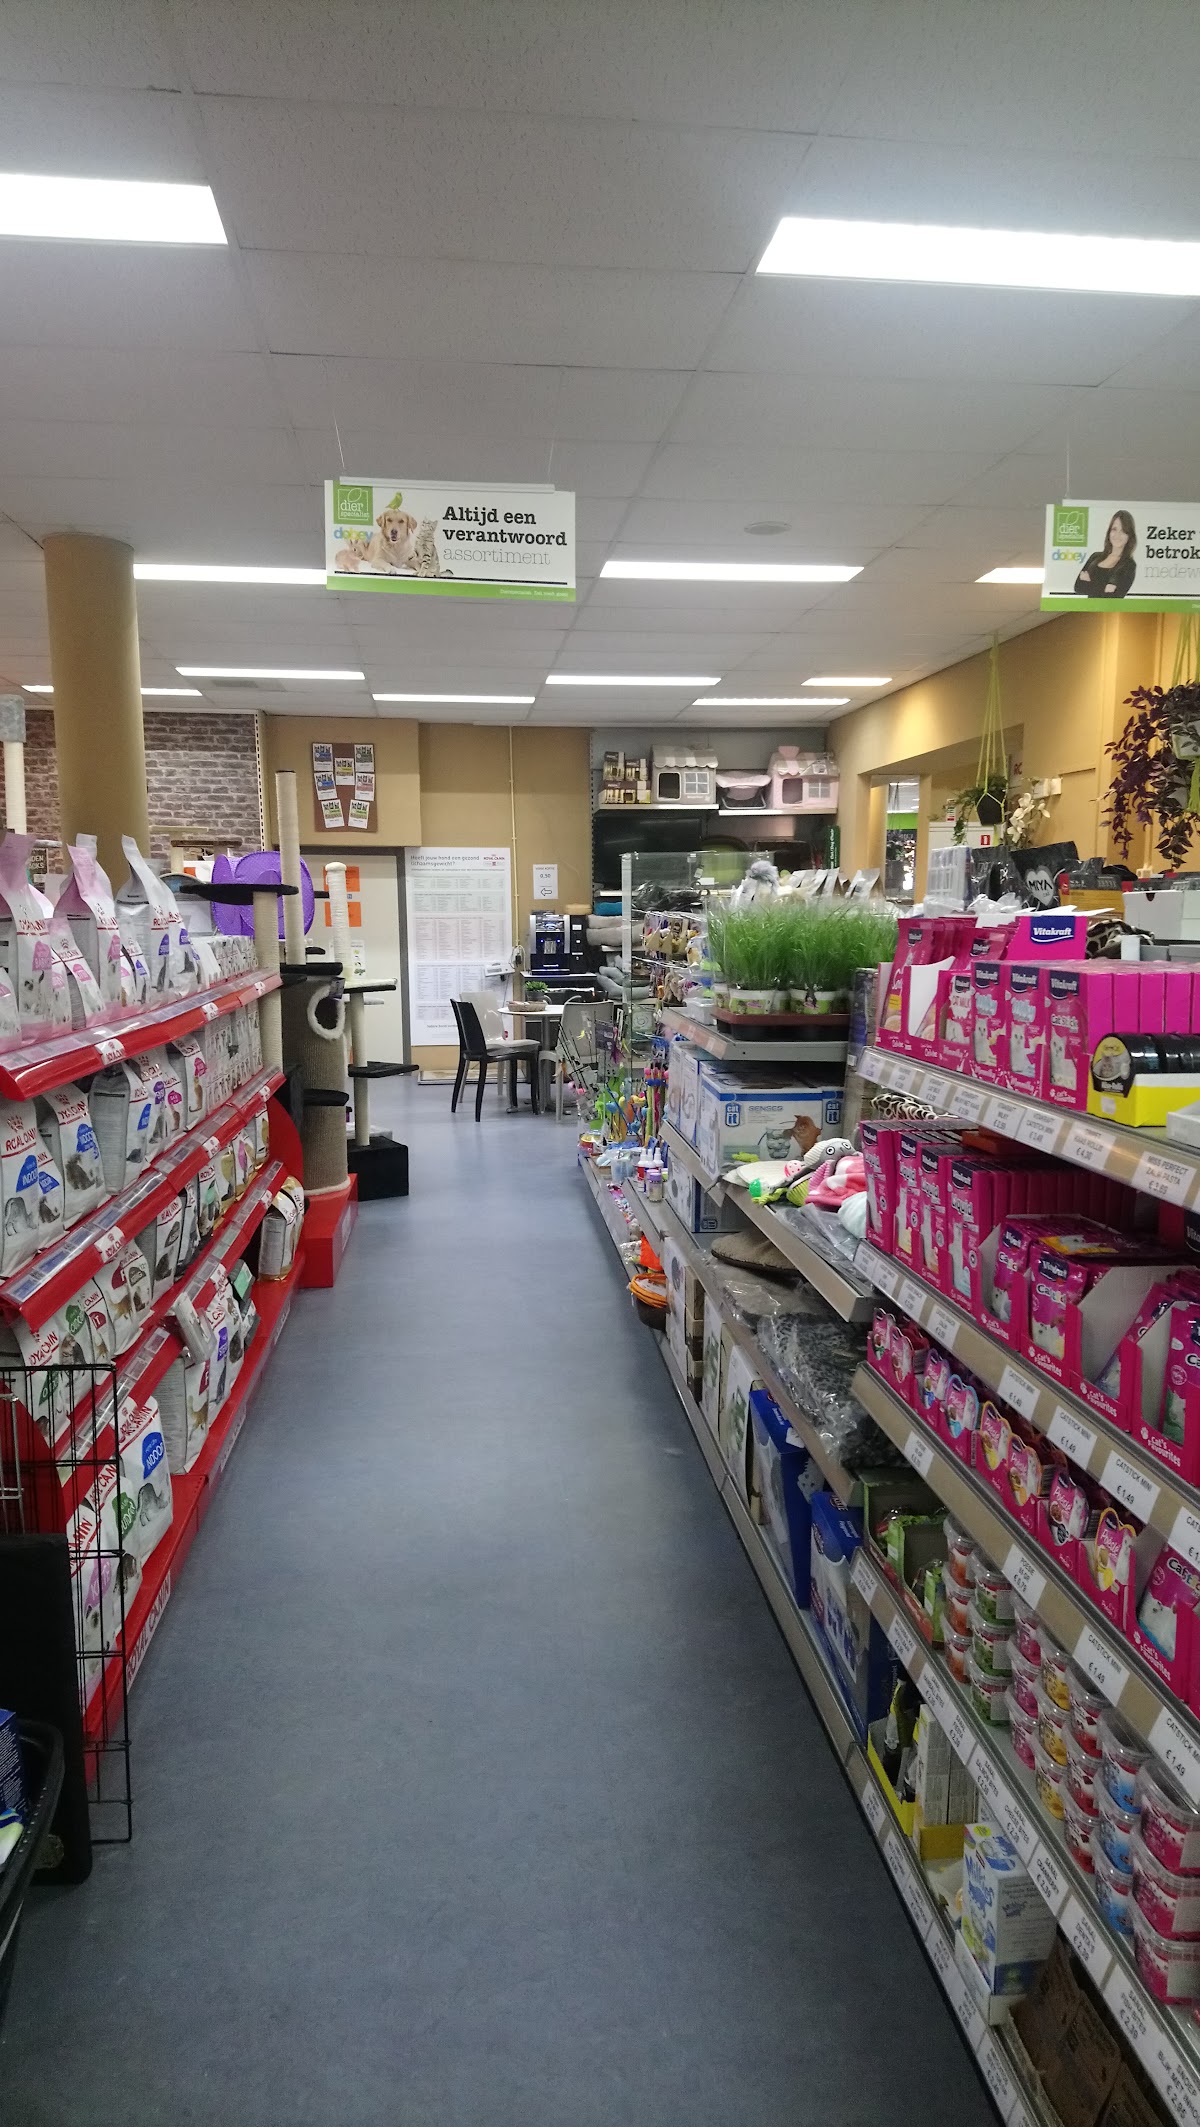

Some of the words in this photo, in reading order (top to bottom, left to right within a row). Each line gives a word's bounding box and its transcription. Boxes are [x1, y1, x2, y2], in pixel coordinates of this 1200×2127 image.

[341, 500, 364, 511] dier
[442, 506, 499, 526] Altijd
[503, 512, 536, 525] een
[333, 527, 373, 542] dobey
[443, 527, 567, 546] verantwoord
[1147, 526, 1195, 541] Zeker
[443, 547, 550, 566] assortiment
[1028, 878, 1053, 892] MIYA
[1033, 927, 1072, 937] Vitakraft
[976, 970, 998, 981] Vitakraft
[1012, 972, 1037, 985] Vitakraft
[1051, 977, 1078, 992] Vitakraft
[728, 1112, 738, 1124] it
[1161, 1161, 1189, 1176] PERFECT
[1161, 1172, 1180, 1185] PASTA
[1087, 1394, 1117, 1418] Favourites
[1060, 1411, 1082, 1434] CATSTICK
[1060, 1436, 1066, 1446] €
[1148, 1440, 1181, 1467] Favourites
[1116, 1458, 1140, 1482] CATSTICK
[1139, 1476, 1153, 1491] MINI
[1116, 1485, 1122, 1495] €
[1101, 1528, 1121, 1553] Poésie
[1088, 1633, 1111, 1665] CATSTICK
[1088, 1661, 1094, 1672] €
[1166, 1717, 1194, 1752] CATSTICK
[1165, 1749, 1172, 1760] €
[1045, 1857, 1058, 1880] SANAL
[1081, 1916, 1097, 1943] SANAL
[1129, 1990, 1146, 2020] SANAL
